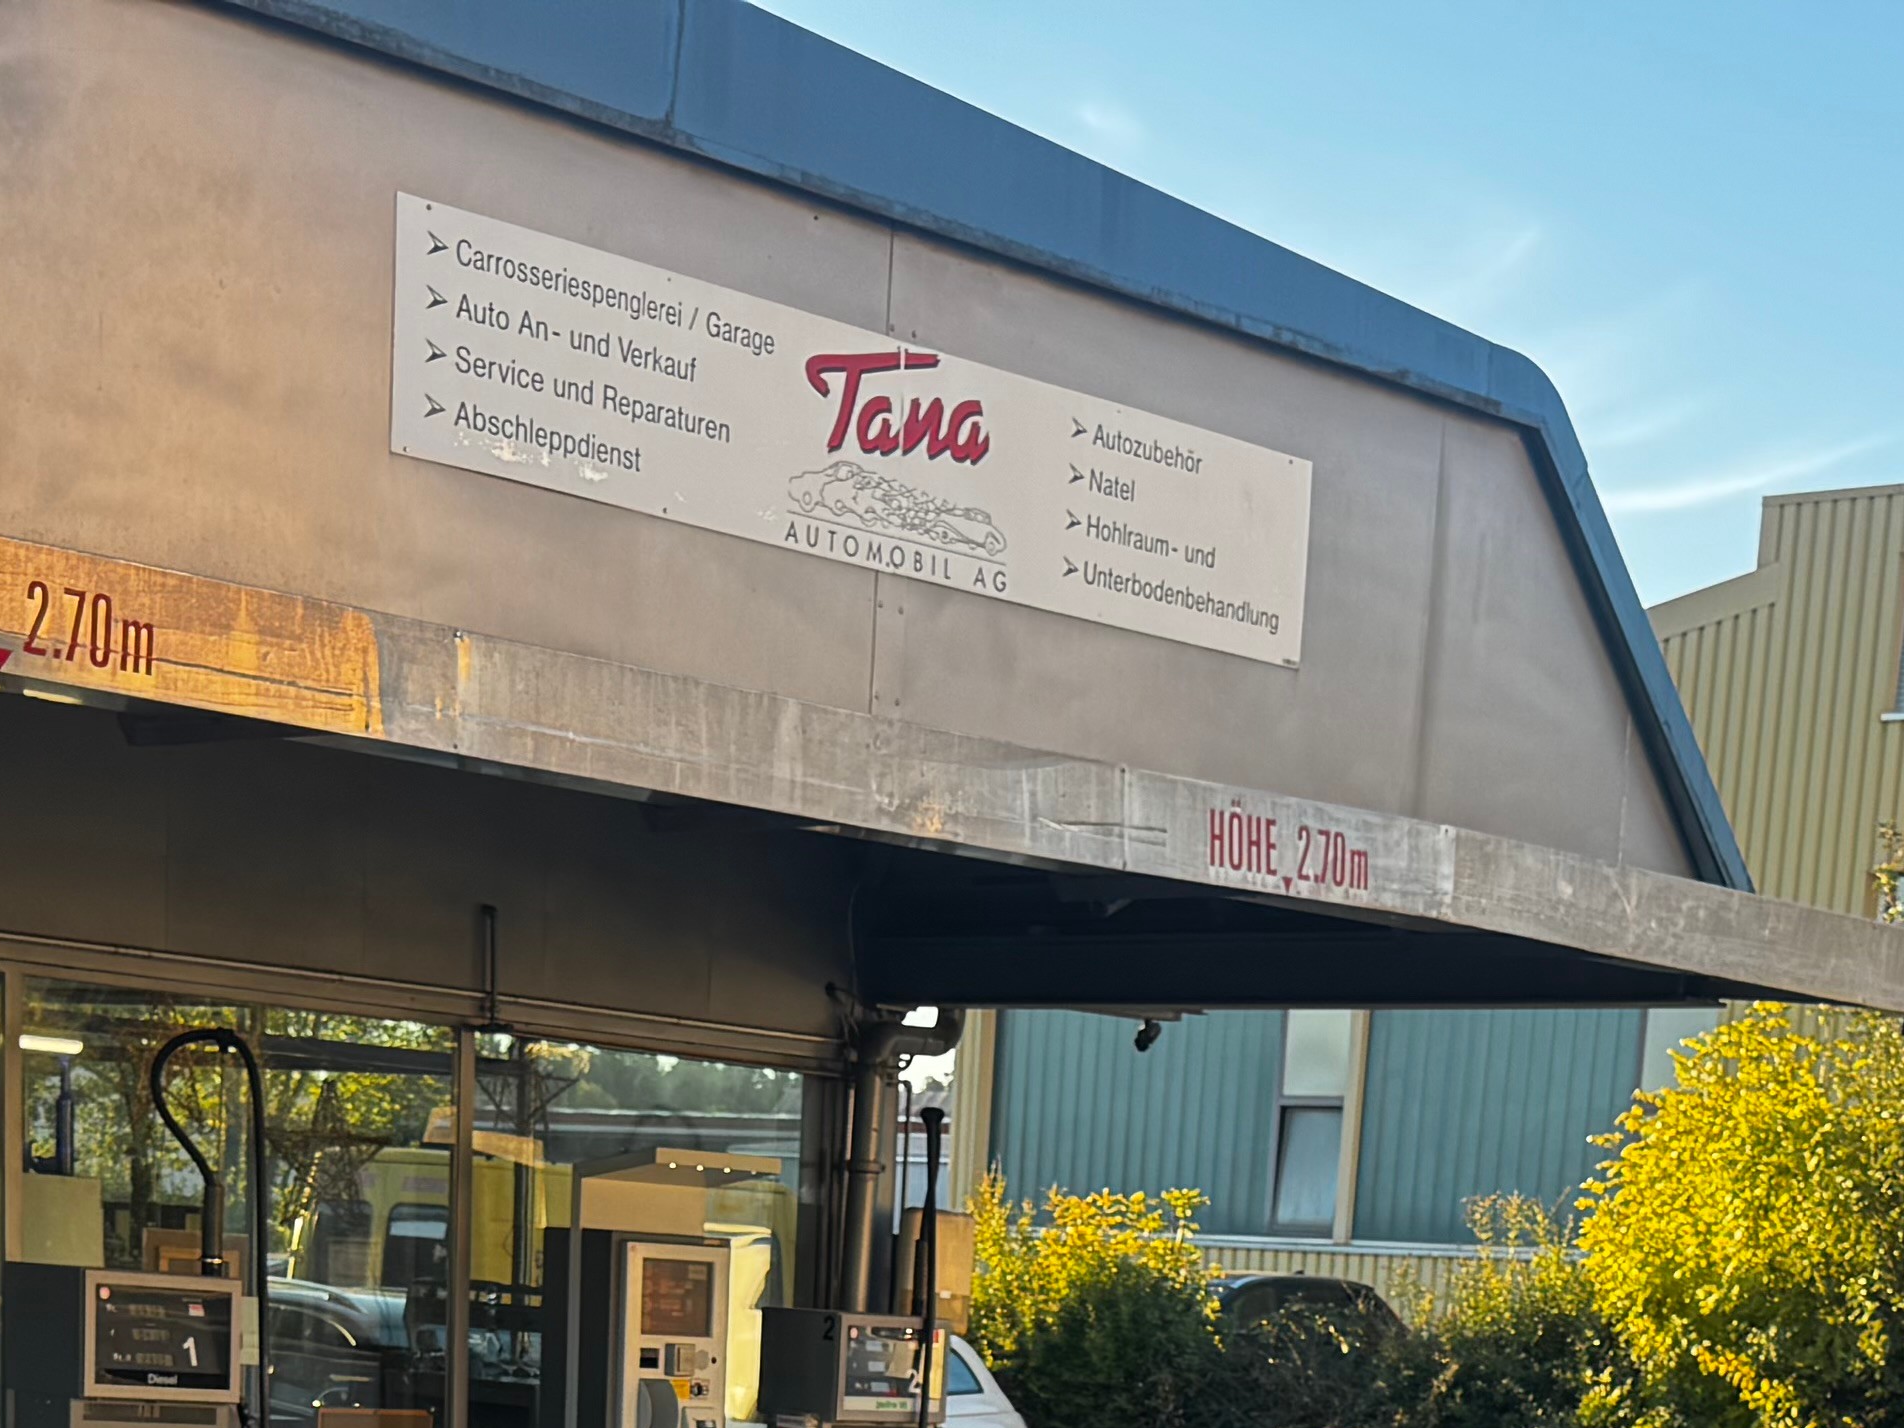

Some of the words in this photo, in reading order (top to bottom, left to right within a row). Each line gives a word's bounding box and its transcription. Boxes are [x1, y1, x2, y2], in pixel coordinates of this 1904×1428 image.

[456, 239, 683, 328] Carrosseriespenglerei
[706, 312, 775, 356] Garage
[456, 294, 510, 331] Auto
[518, 310, 561, 341] An-
[569, 329, 611, 358] und
[618, 336, 696, 383] Verkauf
[455, 347, 544, 391] Service
[553, 375, 594, 406] und
[603, 384, 731, 444] Reparaturen
[805, 351, 990, 465] Tana
[453, 401, 642, 473] Abschleppdienst
[1092, 423, 1203, 476] Autozubehör
[1089, 468, 1136, 503] Natel
[784, 521, 953, 581] AUTOMOBIL
[972, 567, 1008, 594] AG
[1086, 515, 1179, 558] Hohlraum-
[1183, 541, 1217, 568] und
[1083, 559, 1280, 635] Unterbodenbehandlung
[1209, 798, 1278, 876] HÖHE
[181, 1336, 199, 1368] 1
[822, 1315, 836, 1342] 2
[904, 1368, 923, 1394] 2
